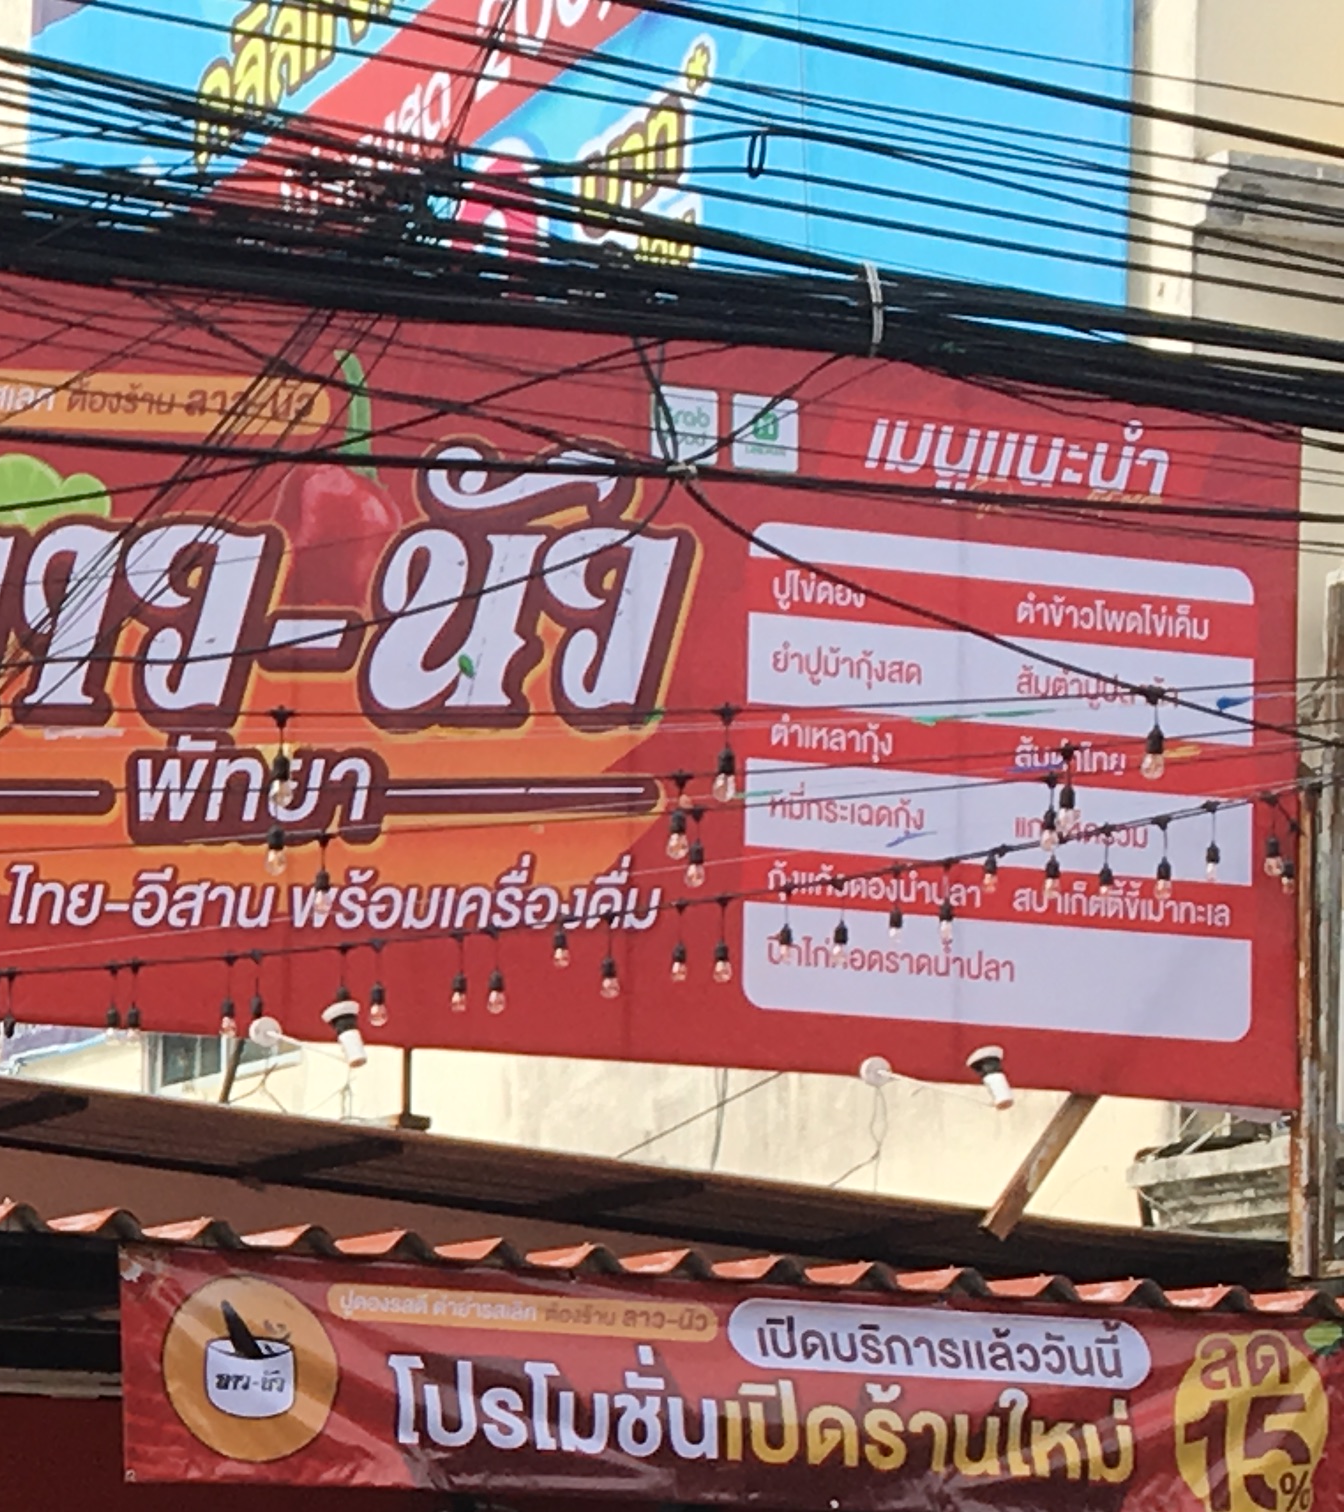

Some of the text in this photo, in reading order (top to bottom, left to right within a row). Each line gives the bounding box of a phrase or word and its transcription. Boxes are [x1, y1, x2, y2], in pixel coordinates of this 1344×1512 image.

[864, 419, 1170, 505] เมนูแนะนำ
[1016, 592, 1210, 641] ตำข้าวโพดไข่เค็ม
[772, 642, 923, 690] ยำปูม้ากุ้งสด
[137, 736, 372, 823] พัทยา
[12, 865, 275, 929] ไทย-อีสาน
[293, 855, 662, 931] พร้อมเครื่องดื่ม
[757, 1316, 1124, 1379] เปิดบริการแล้ววันนี้
[1199, 1330, 1292, 1392] ลด
